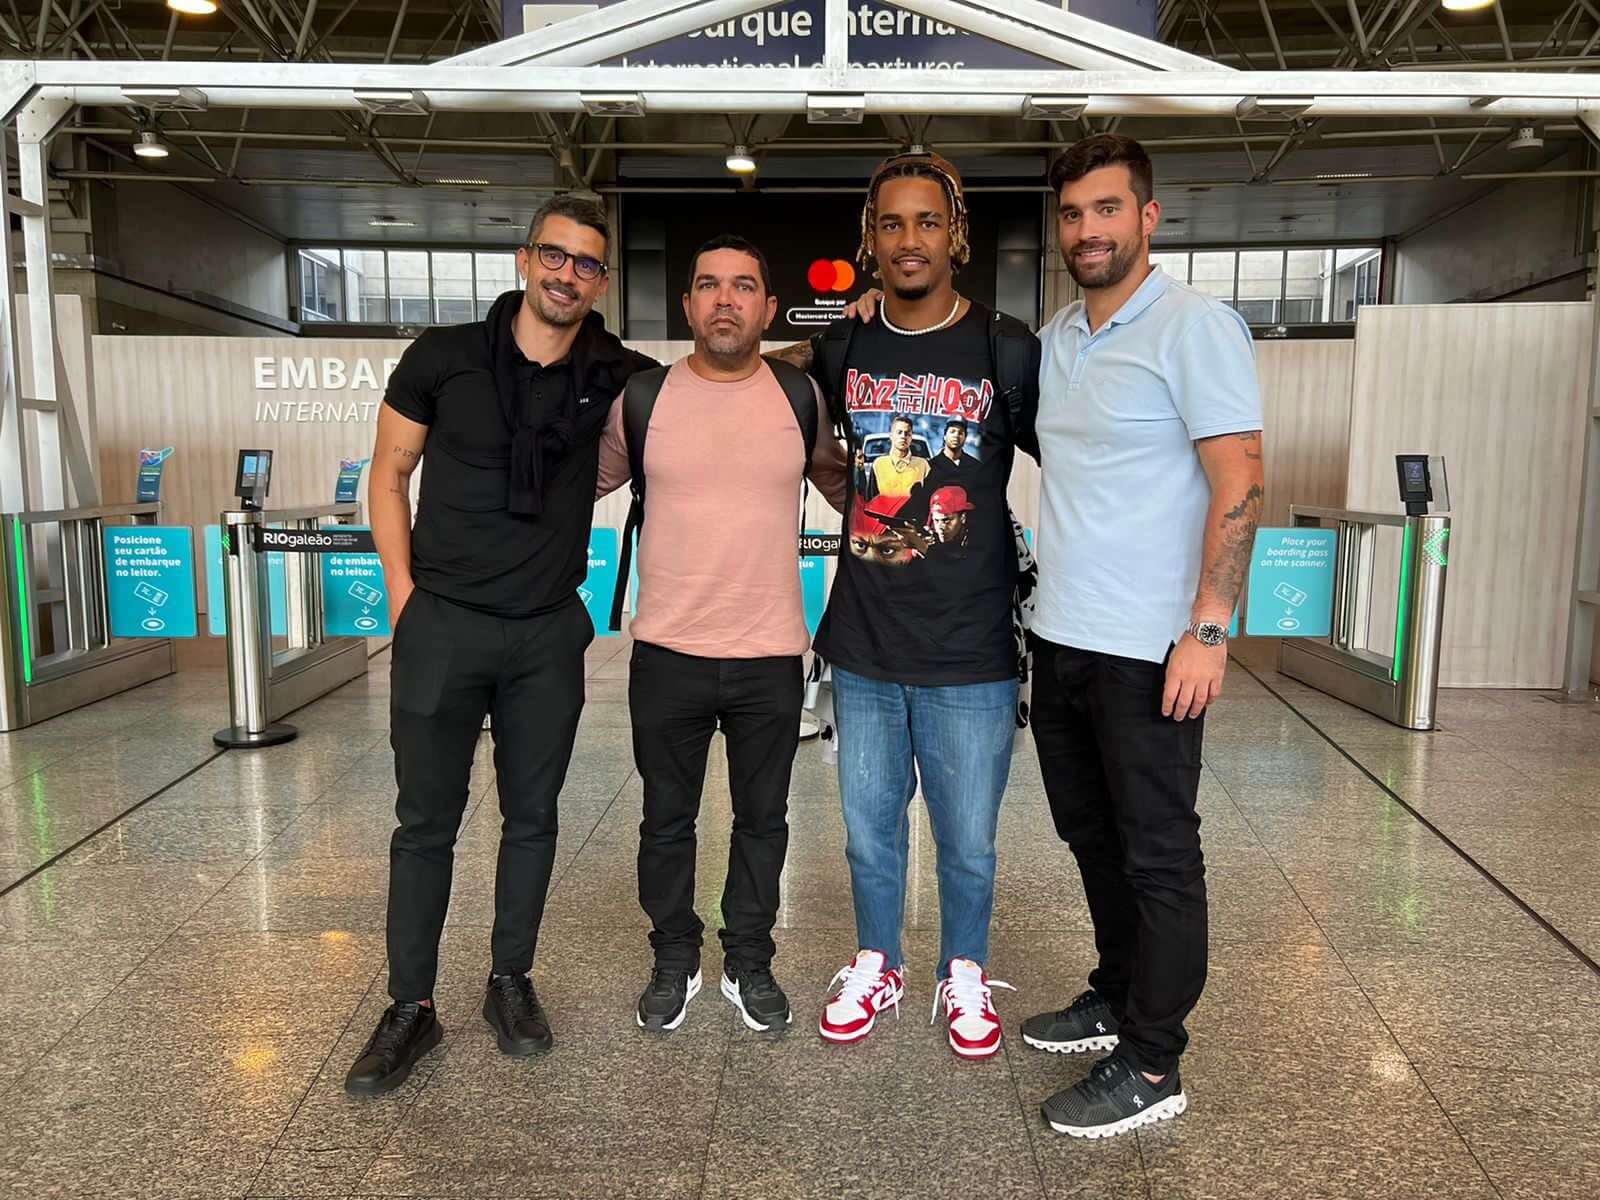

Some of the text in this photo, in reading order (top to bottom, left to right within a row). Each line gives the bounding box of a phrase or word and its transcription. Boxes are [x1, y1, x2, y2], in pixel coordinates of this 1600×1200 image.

[897, 395, 923, 415] THE
[923, 372, 994, 423] HOOD
[113, 535, 162, 545] Posicione
[263, 532, 332, 547] RIOgaleão
[1280, 536, 1327, 548] Place your
[114, 546, 168, 555] seu cartão
[1266, 547, 1328, 558] boarding pass
[115, 557, 181, 568] de embarque
[330, 557, 343, 565] de
[1260, 558, 1327, 567] on the scanner.
[115, 567, 162, 577] no leitor.
[331, 567, 376, 577] no leitor.
